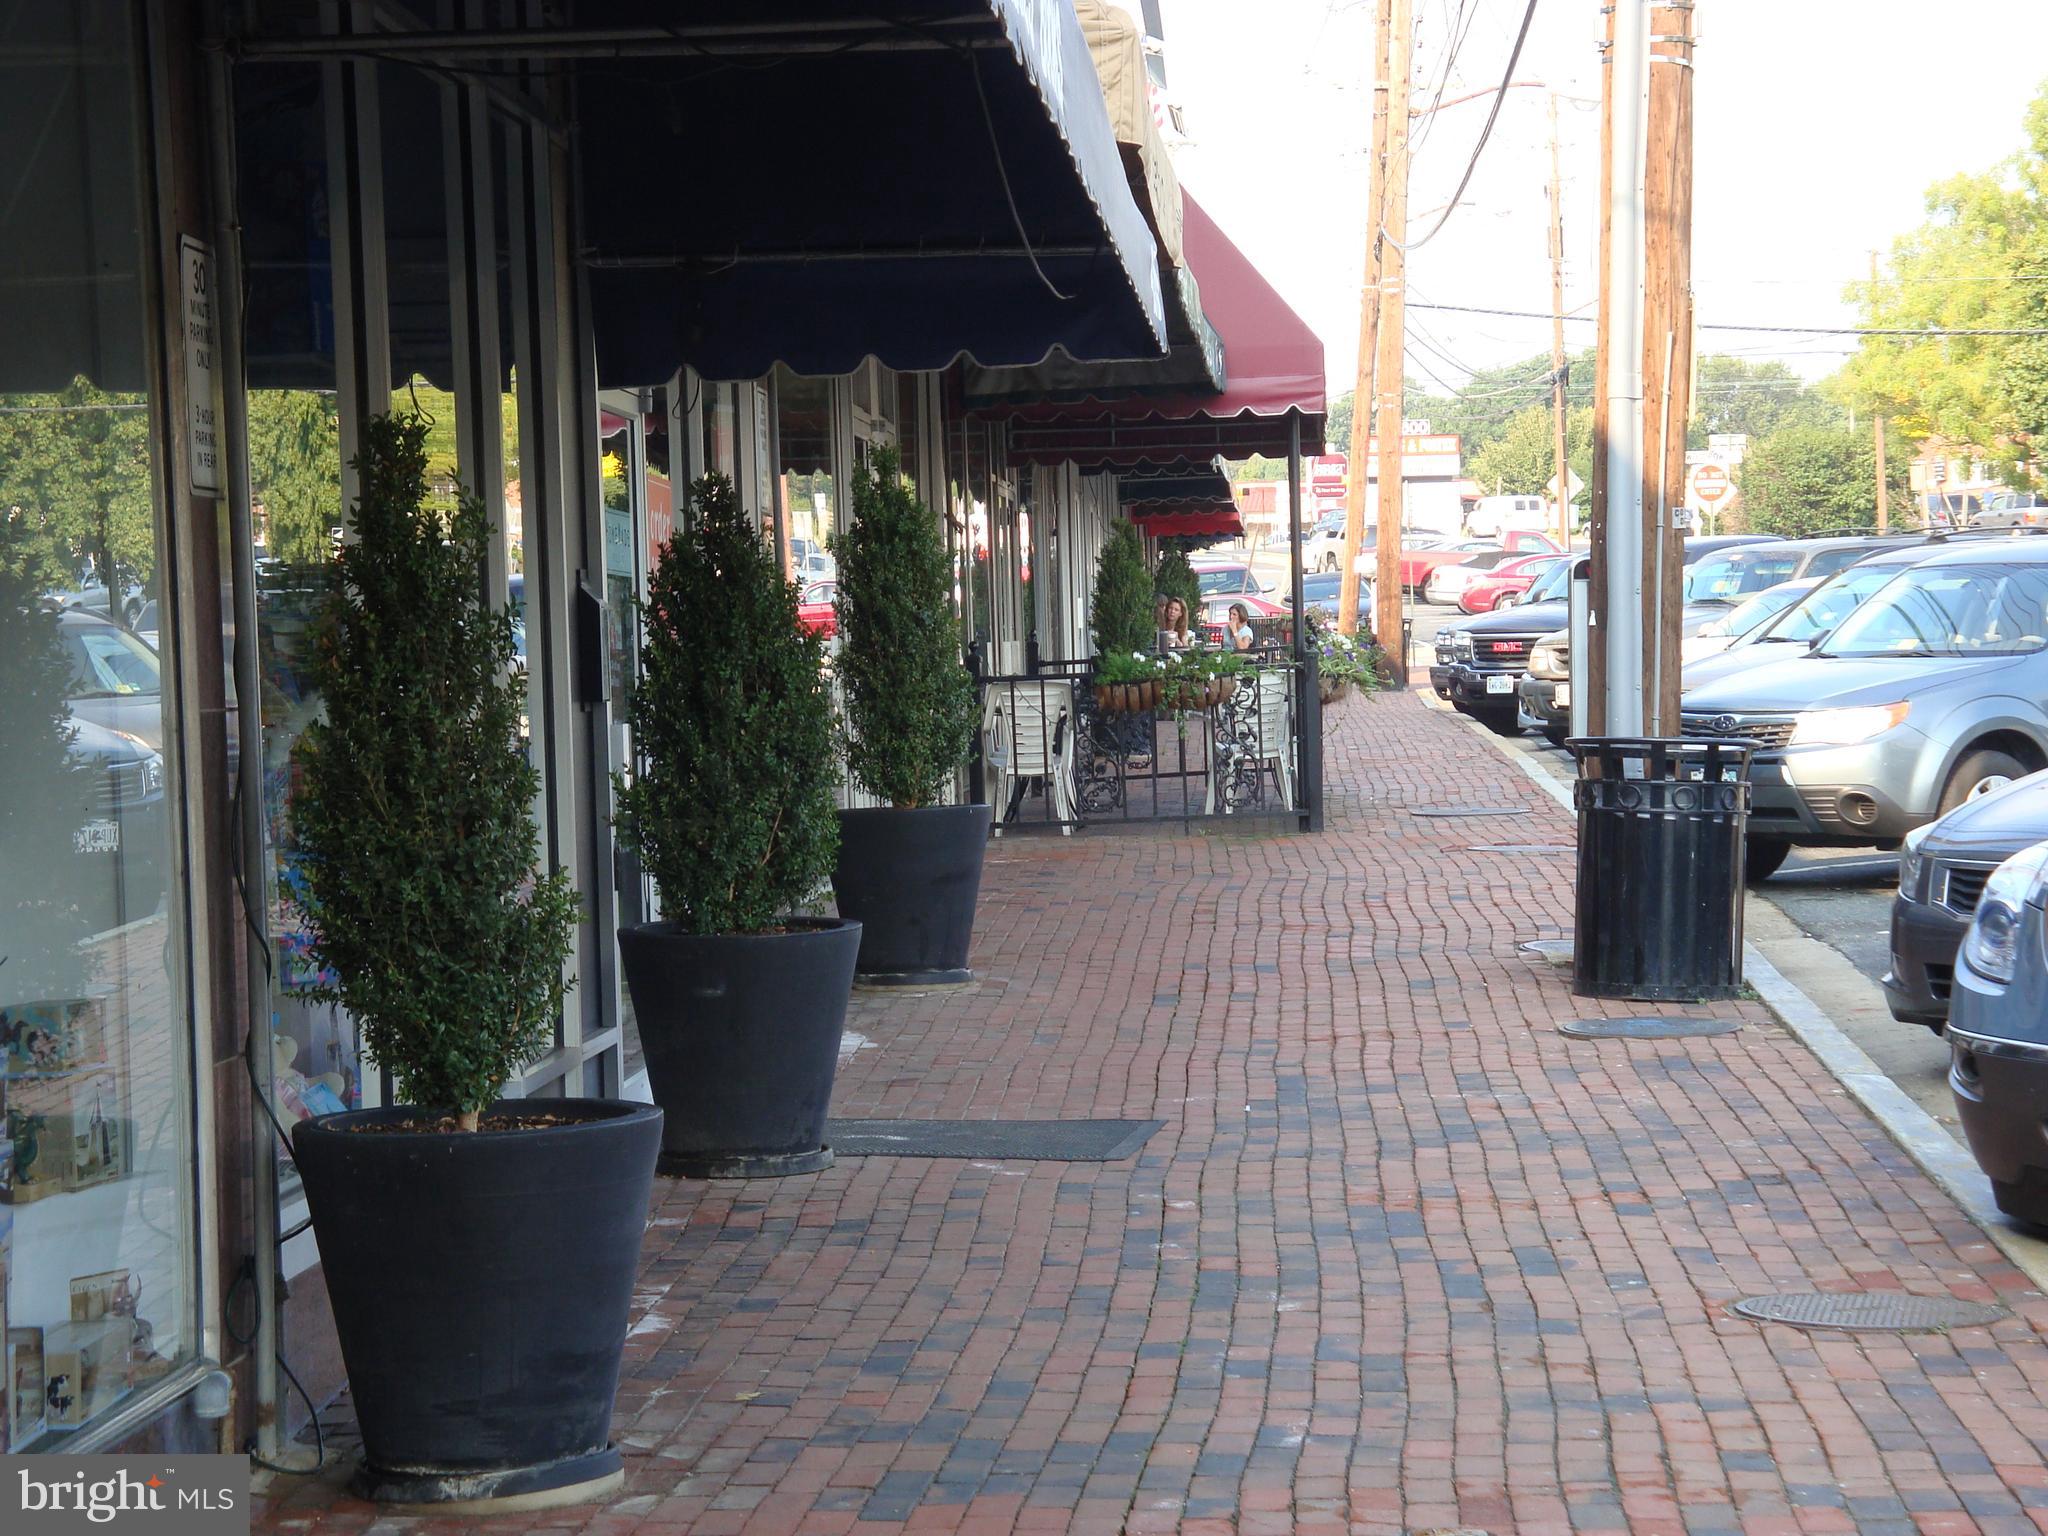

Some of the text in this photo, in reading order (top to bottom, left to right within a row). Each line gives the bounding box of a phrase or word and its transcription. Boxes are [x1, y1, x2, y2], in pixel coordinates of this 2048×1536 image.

[192, 258, 206, 296] 30
[190, 298, 211, 321] MINUTE
[190, 321, 214, 345] PARKING
[196, 348, 210, 371] ONLY
[195, 429, 217, 448] PARKING
[650, 503, 672, 545] order
[1491, 641, 1523, 653] GMC
